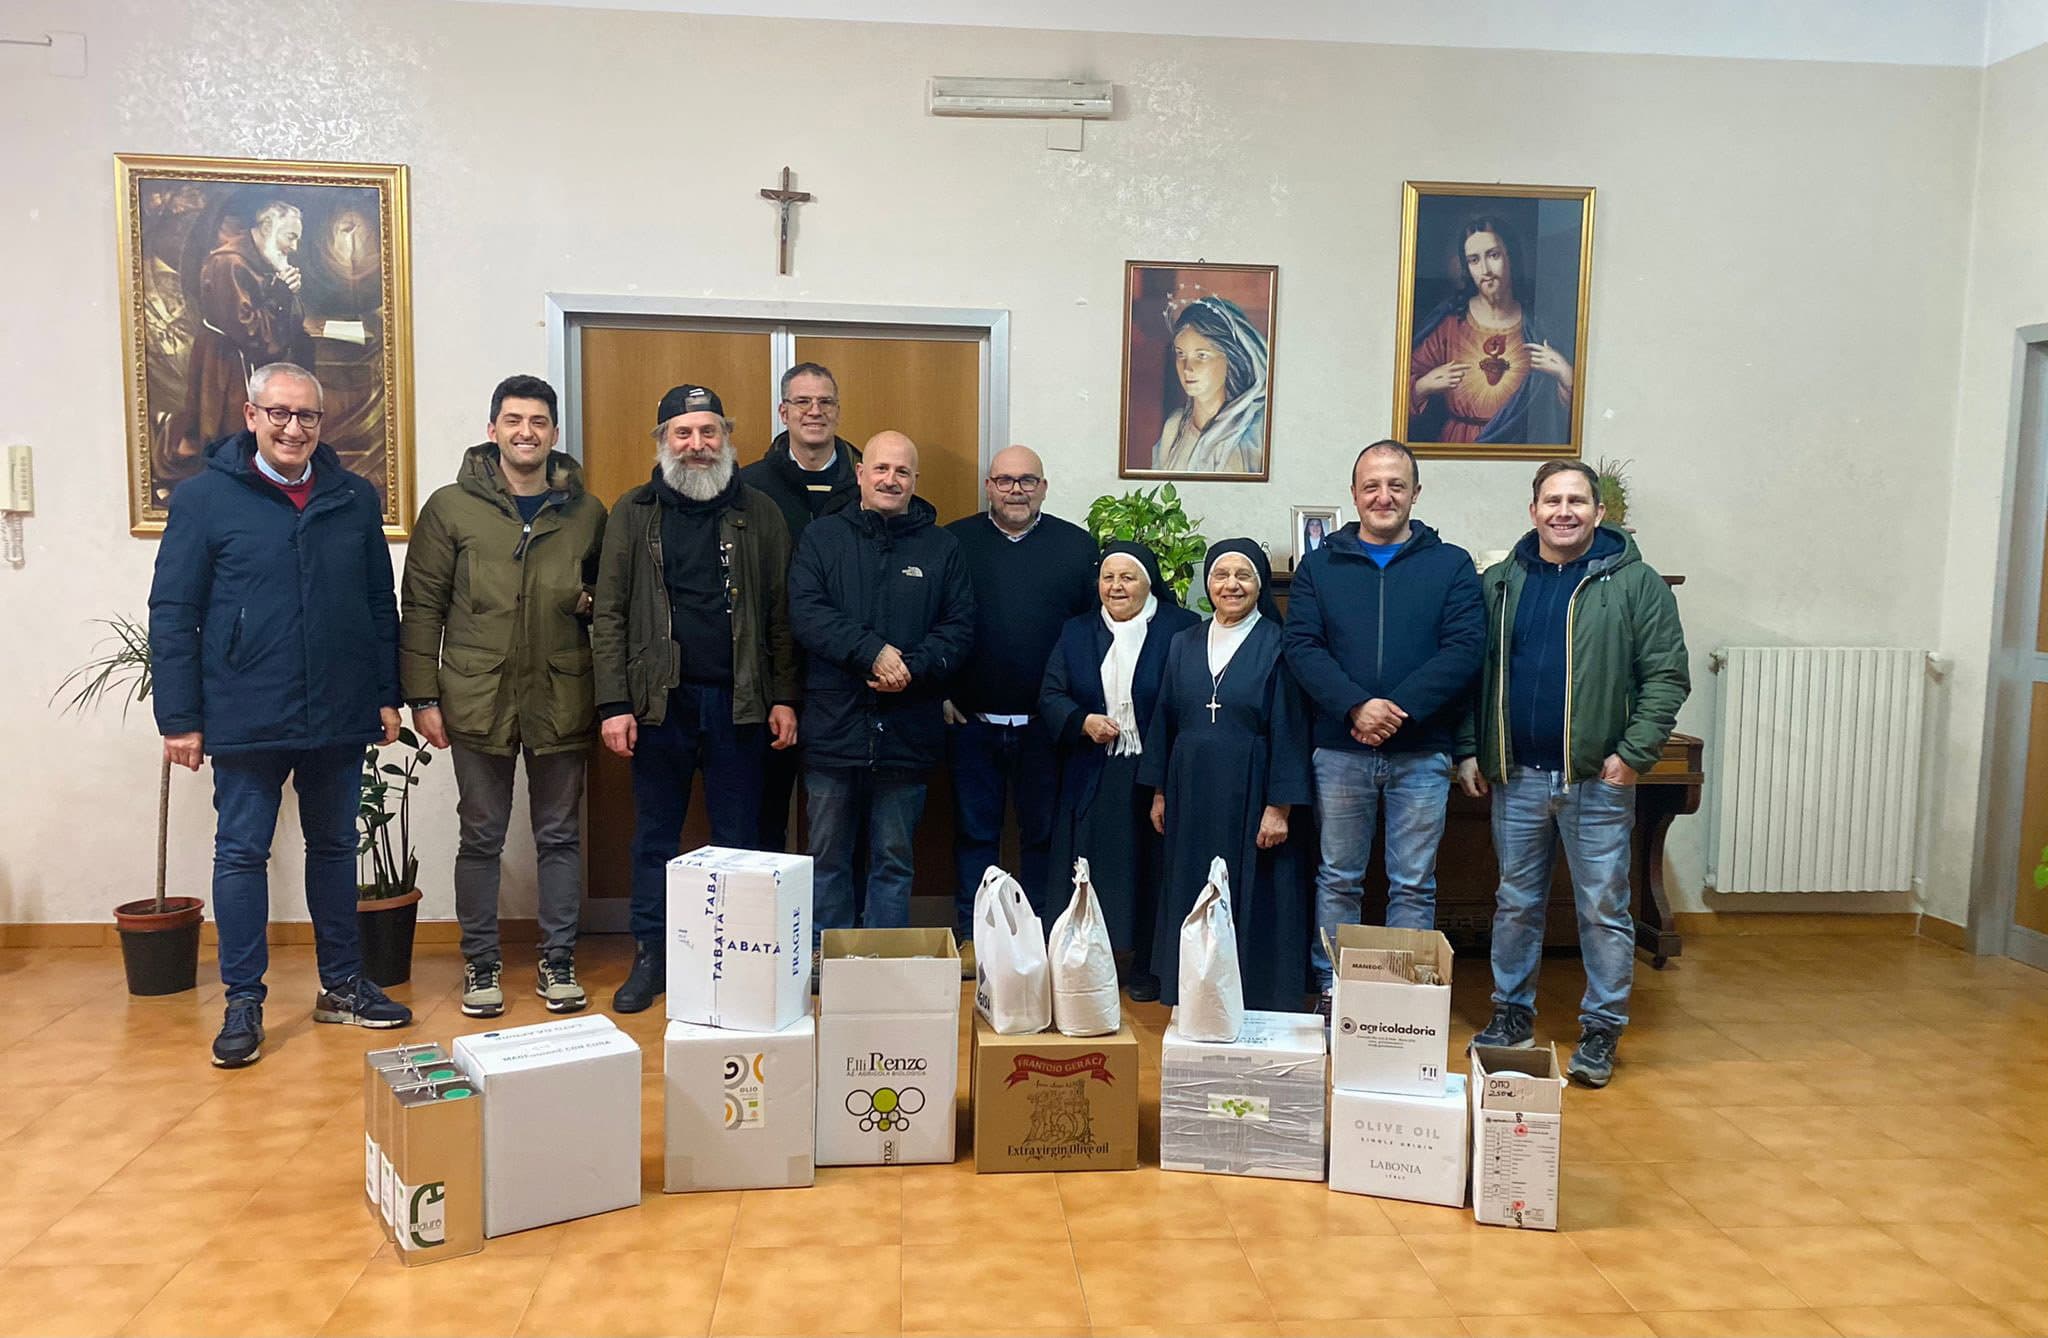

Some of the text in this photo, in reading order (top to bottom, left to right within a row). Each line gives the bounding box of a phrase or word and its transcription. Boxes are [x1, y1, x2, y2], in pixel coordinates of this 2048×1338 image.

[727, 940, 781, 954] ABATÀ
[792, 906, 800, 976] FRAGILE
[1359, 1022, 1436, 1036] agricoladoria
[869, 1052, 928, 1071] Renzo
[1018, 1055, 1104, 1073] FRANTOIO GERACI
[1354, 1119, 1440, 1140] OLIVE OIL
[1370, 1159, 1422, 1175] LABONIA
